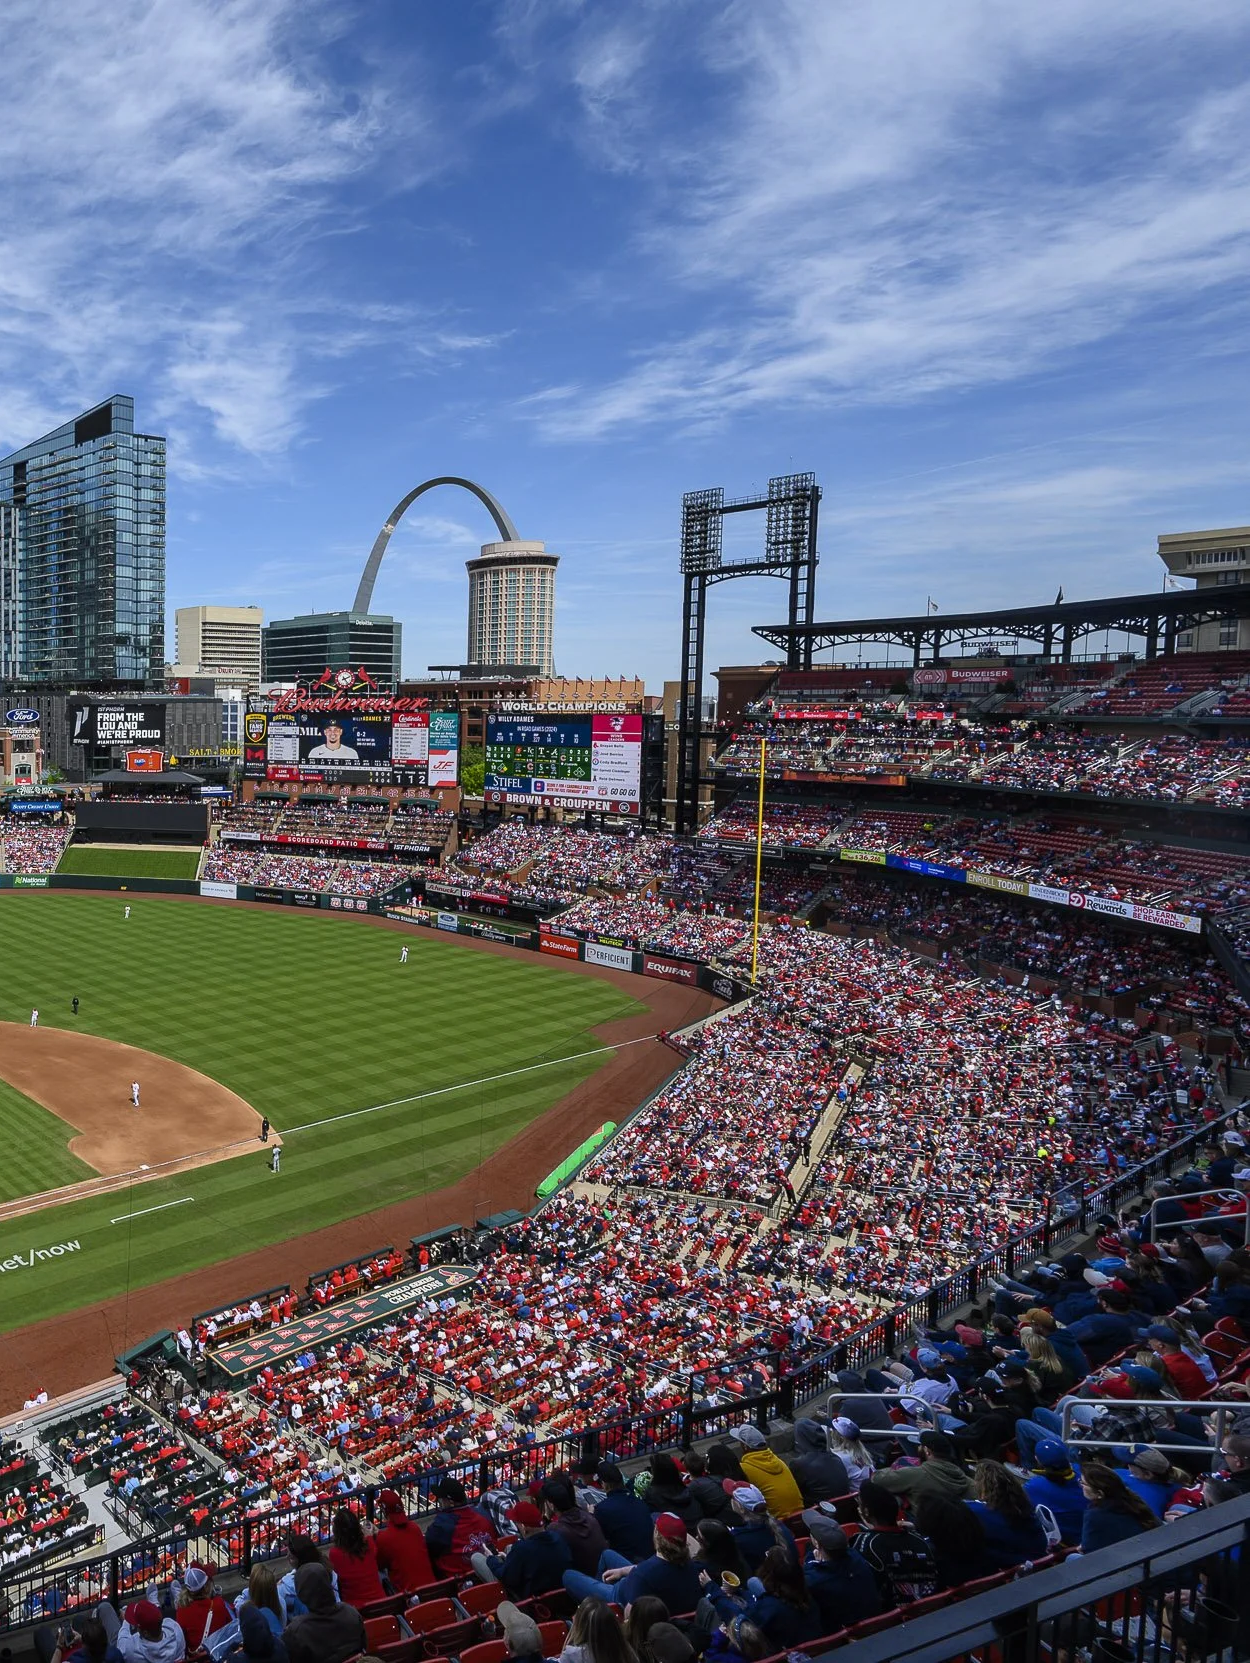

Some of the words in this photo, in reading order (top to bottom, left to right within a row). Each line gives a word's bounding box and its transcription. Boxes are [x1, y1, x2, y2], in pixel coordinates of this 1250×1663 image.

[952, 670, 1008, 678] BUDWEISER
[268, 688, 429, 713] Budweiser
[502, 702, 544, 711] WORLD
[547, 702, 626, 711] CHAMPIONS
[13, 710, 34, 720] Ford
[97, 713, 124, 721] FROM
[126, 713, 145, 721] THE
[97, 722, 116, 730] LOU
[117, 722, 138, 730] AND
[300, 726, 321, 736] MIL
[97, 730, 128, 739] WE'RE
[130, 730, 161, 738] PROUD
[419, 776, 426, 784] 2
[493, 777, 523, 788] STIFEL
[610, 788, 618, 796] GO
[619, 788, 627, 796] GO
[628, 789, 637, 797] GO
[506, 793, 542, 805] BROWN
[544, 798, 550, 806] &
[554, 797, 611, 811] CROUPPEN
[288, 836, 334, 845] SCOREBOARD
[336, 839, 358, 847] PATIO
[968, 874, 995, 887] ENROLL
[997, 880, 1024, 893] TODAY!
[462, 889, 471, 897] UP
[1086, 899, 1127, 915] Rewards
[1133, 906, 1154, 916] SHOP.
[1156, 910, 1179, 921] EARN.
[1143, 915, 1188, 930] REWARDED.
[586, 947, 630, 965] PERFICIENT
[647, 962, 691, 978] EQUIFAX
[380, 1285, 410, 1299] WORLD
[409, 1276, 435, 1289] SERIES
[389, 1280, 444, 1304] CHAMPIONS
